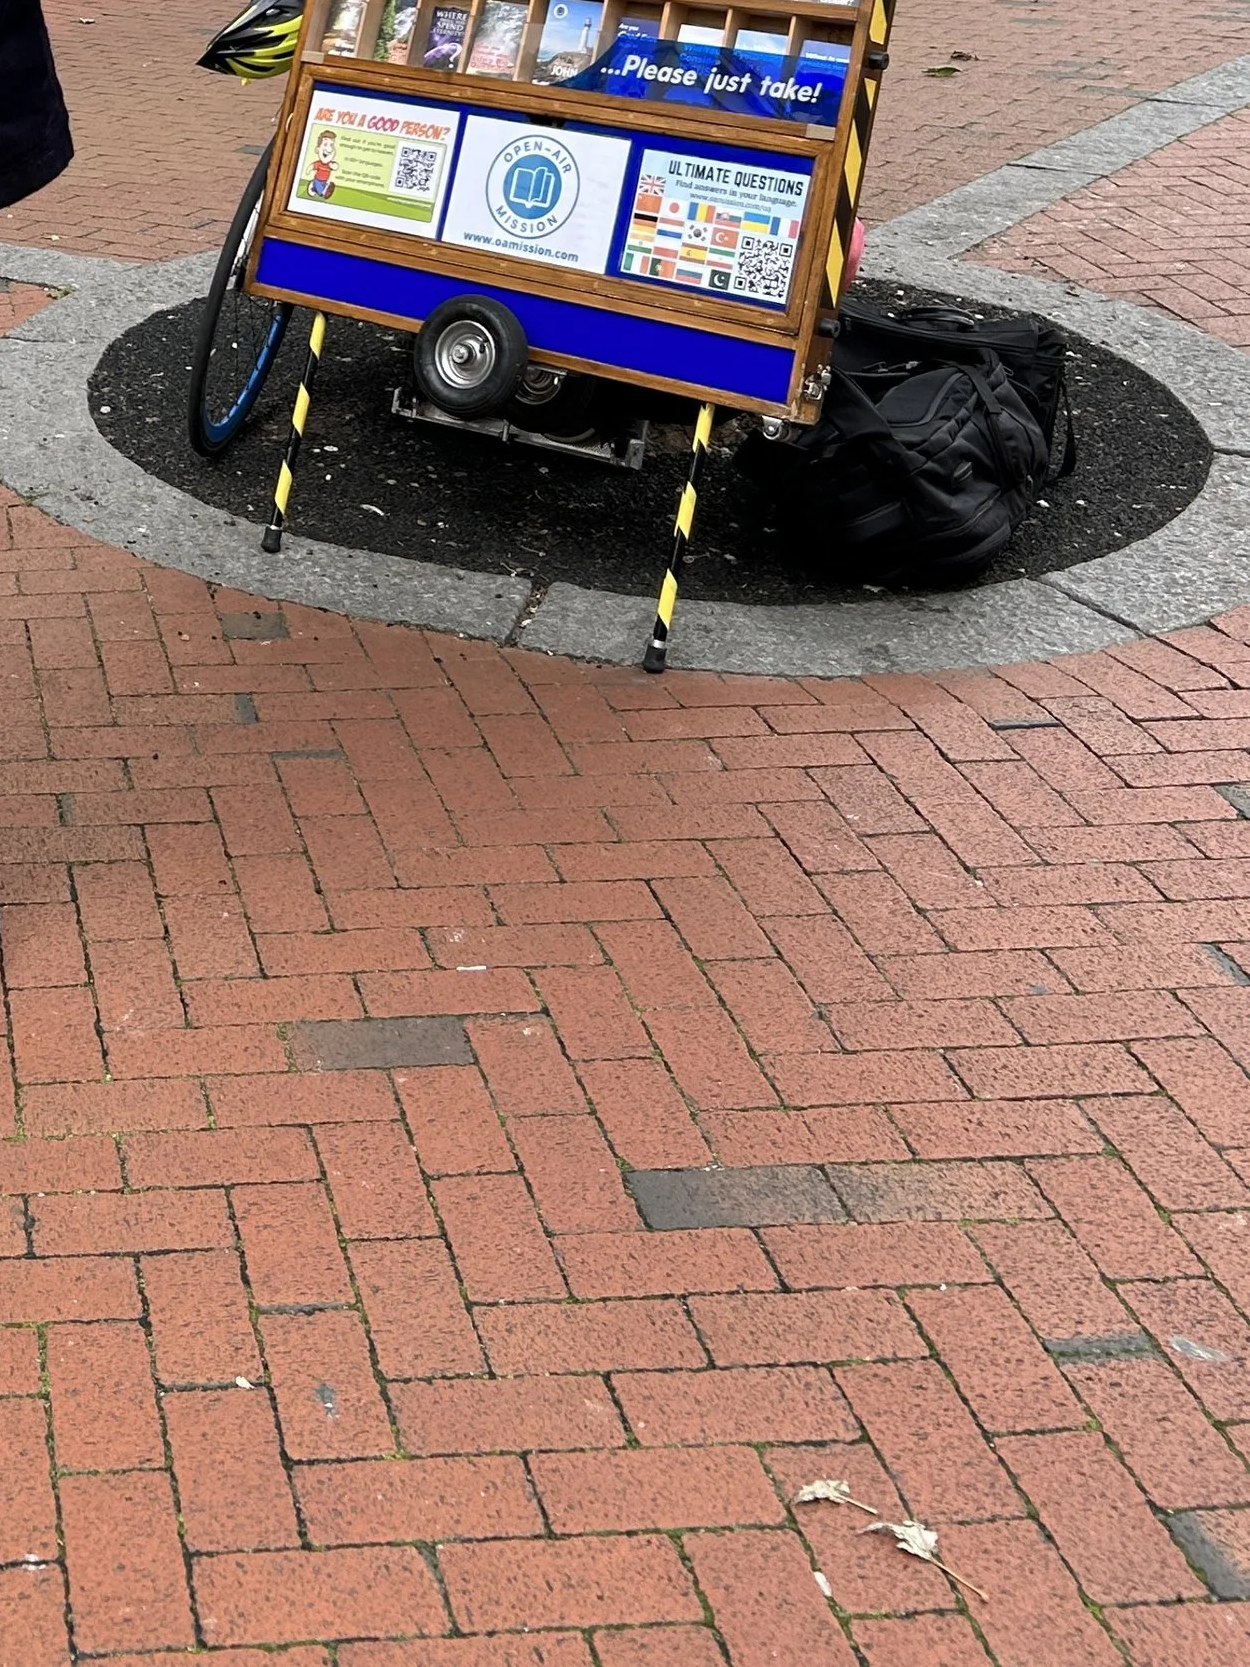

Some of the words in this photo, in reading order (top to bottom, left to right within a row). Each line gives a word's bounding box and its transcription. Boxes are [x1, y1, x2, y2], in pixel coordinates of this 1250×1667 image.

[436, 10, 468, 21] WHERE
[550, 64, 579, 78] JOHN
[600, 55, 698, 85] ...Please
[703, 67, 752, 94] just
[759, 74, 823, 104] take!
[314, 108, 336, 122] ARE
[337, 111, 358, 126] YOU
[358, 114, 367, 127] A
[367, 116, 400, 132] GOOD
[400, 120, 451, 141] PERSON?
[503, 140, 572, 174] OPEN-AIR
[668, 160, 732, 184] ULTIMATE
[734, 171, 804, 196] QUESTIONS
[675, 179, 693, 189] Find
[693, 183, 728, 195] answers
[729, 188, 737, 197] in
[738, 191, 758, 202] your
[758, 193, 798, 208] language.
[495, 205, 558, 234] MISSION
[463, 232, 579, 263] www.oamission.com
